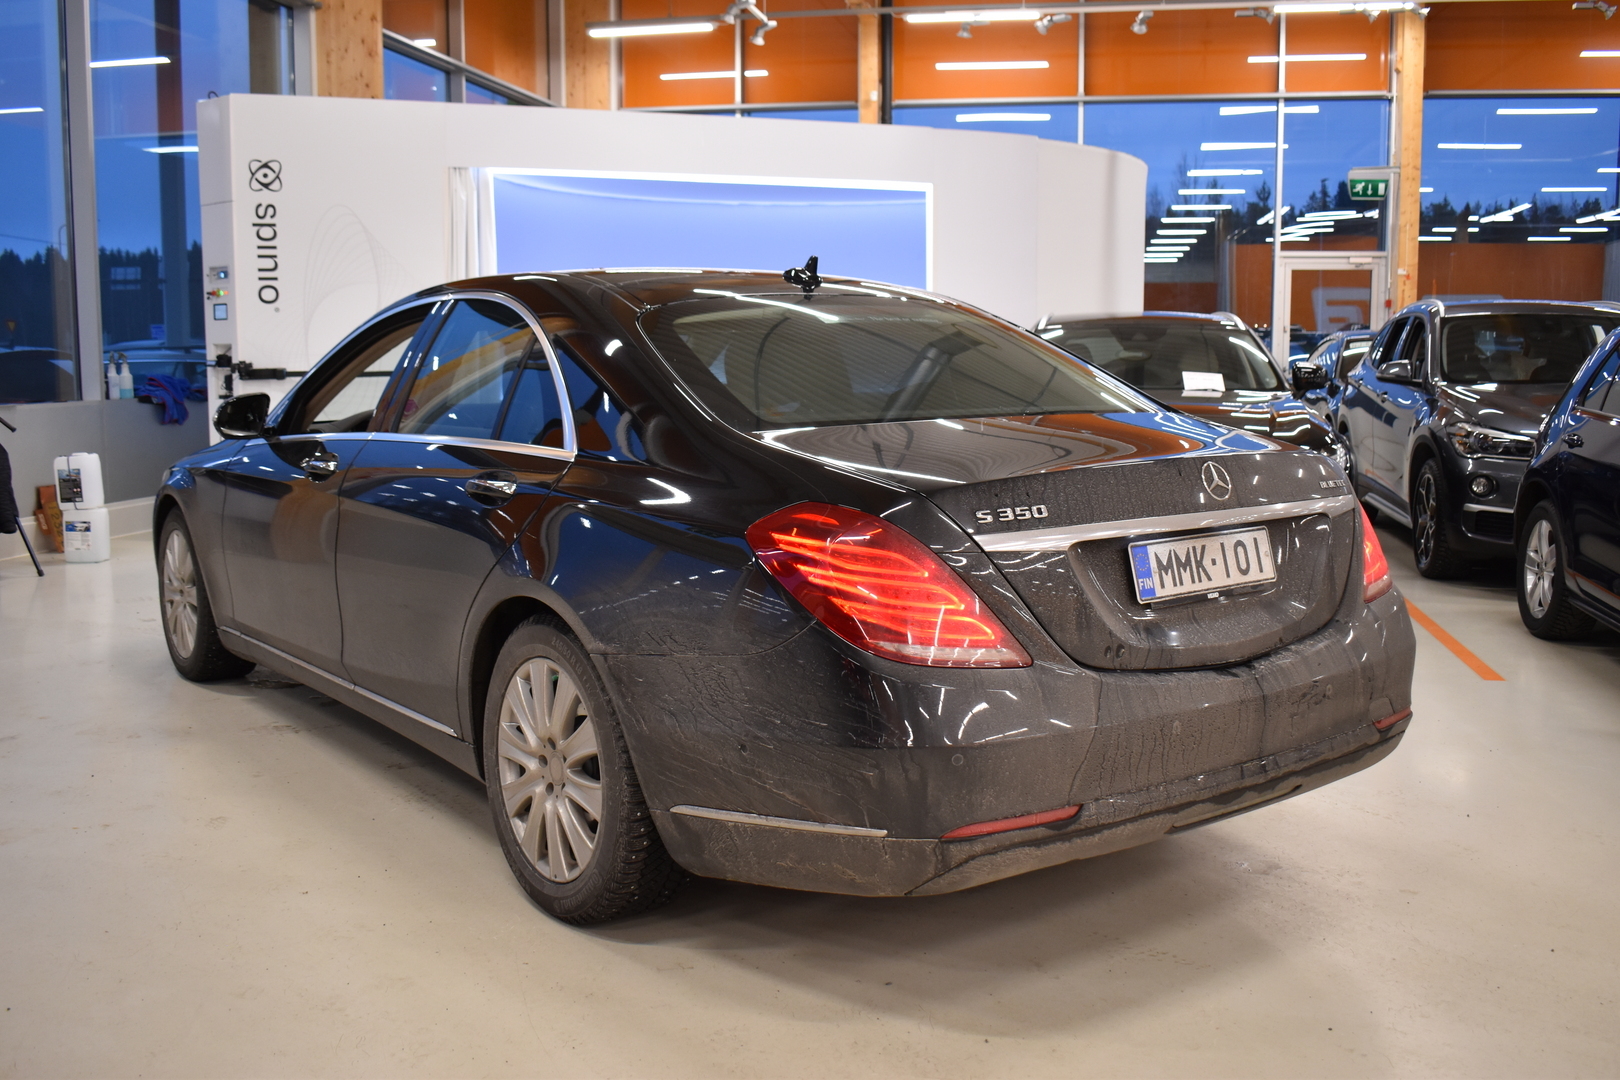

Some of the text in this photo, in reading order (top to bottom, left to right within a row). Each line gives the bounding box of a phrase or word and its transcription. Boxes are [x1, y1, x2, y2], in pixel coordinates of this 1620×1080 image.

[975, 504, 1049, 523] S 350
[1154, 537, 1263, 589] MMK-101
[1138, 577, 1153, 590] FIN
